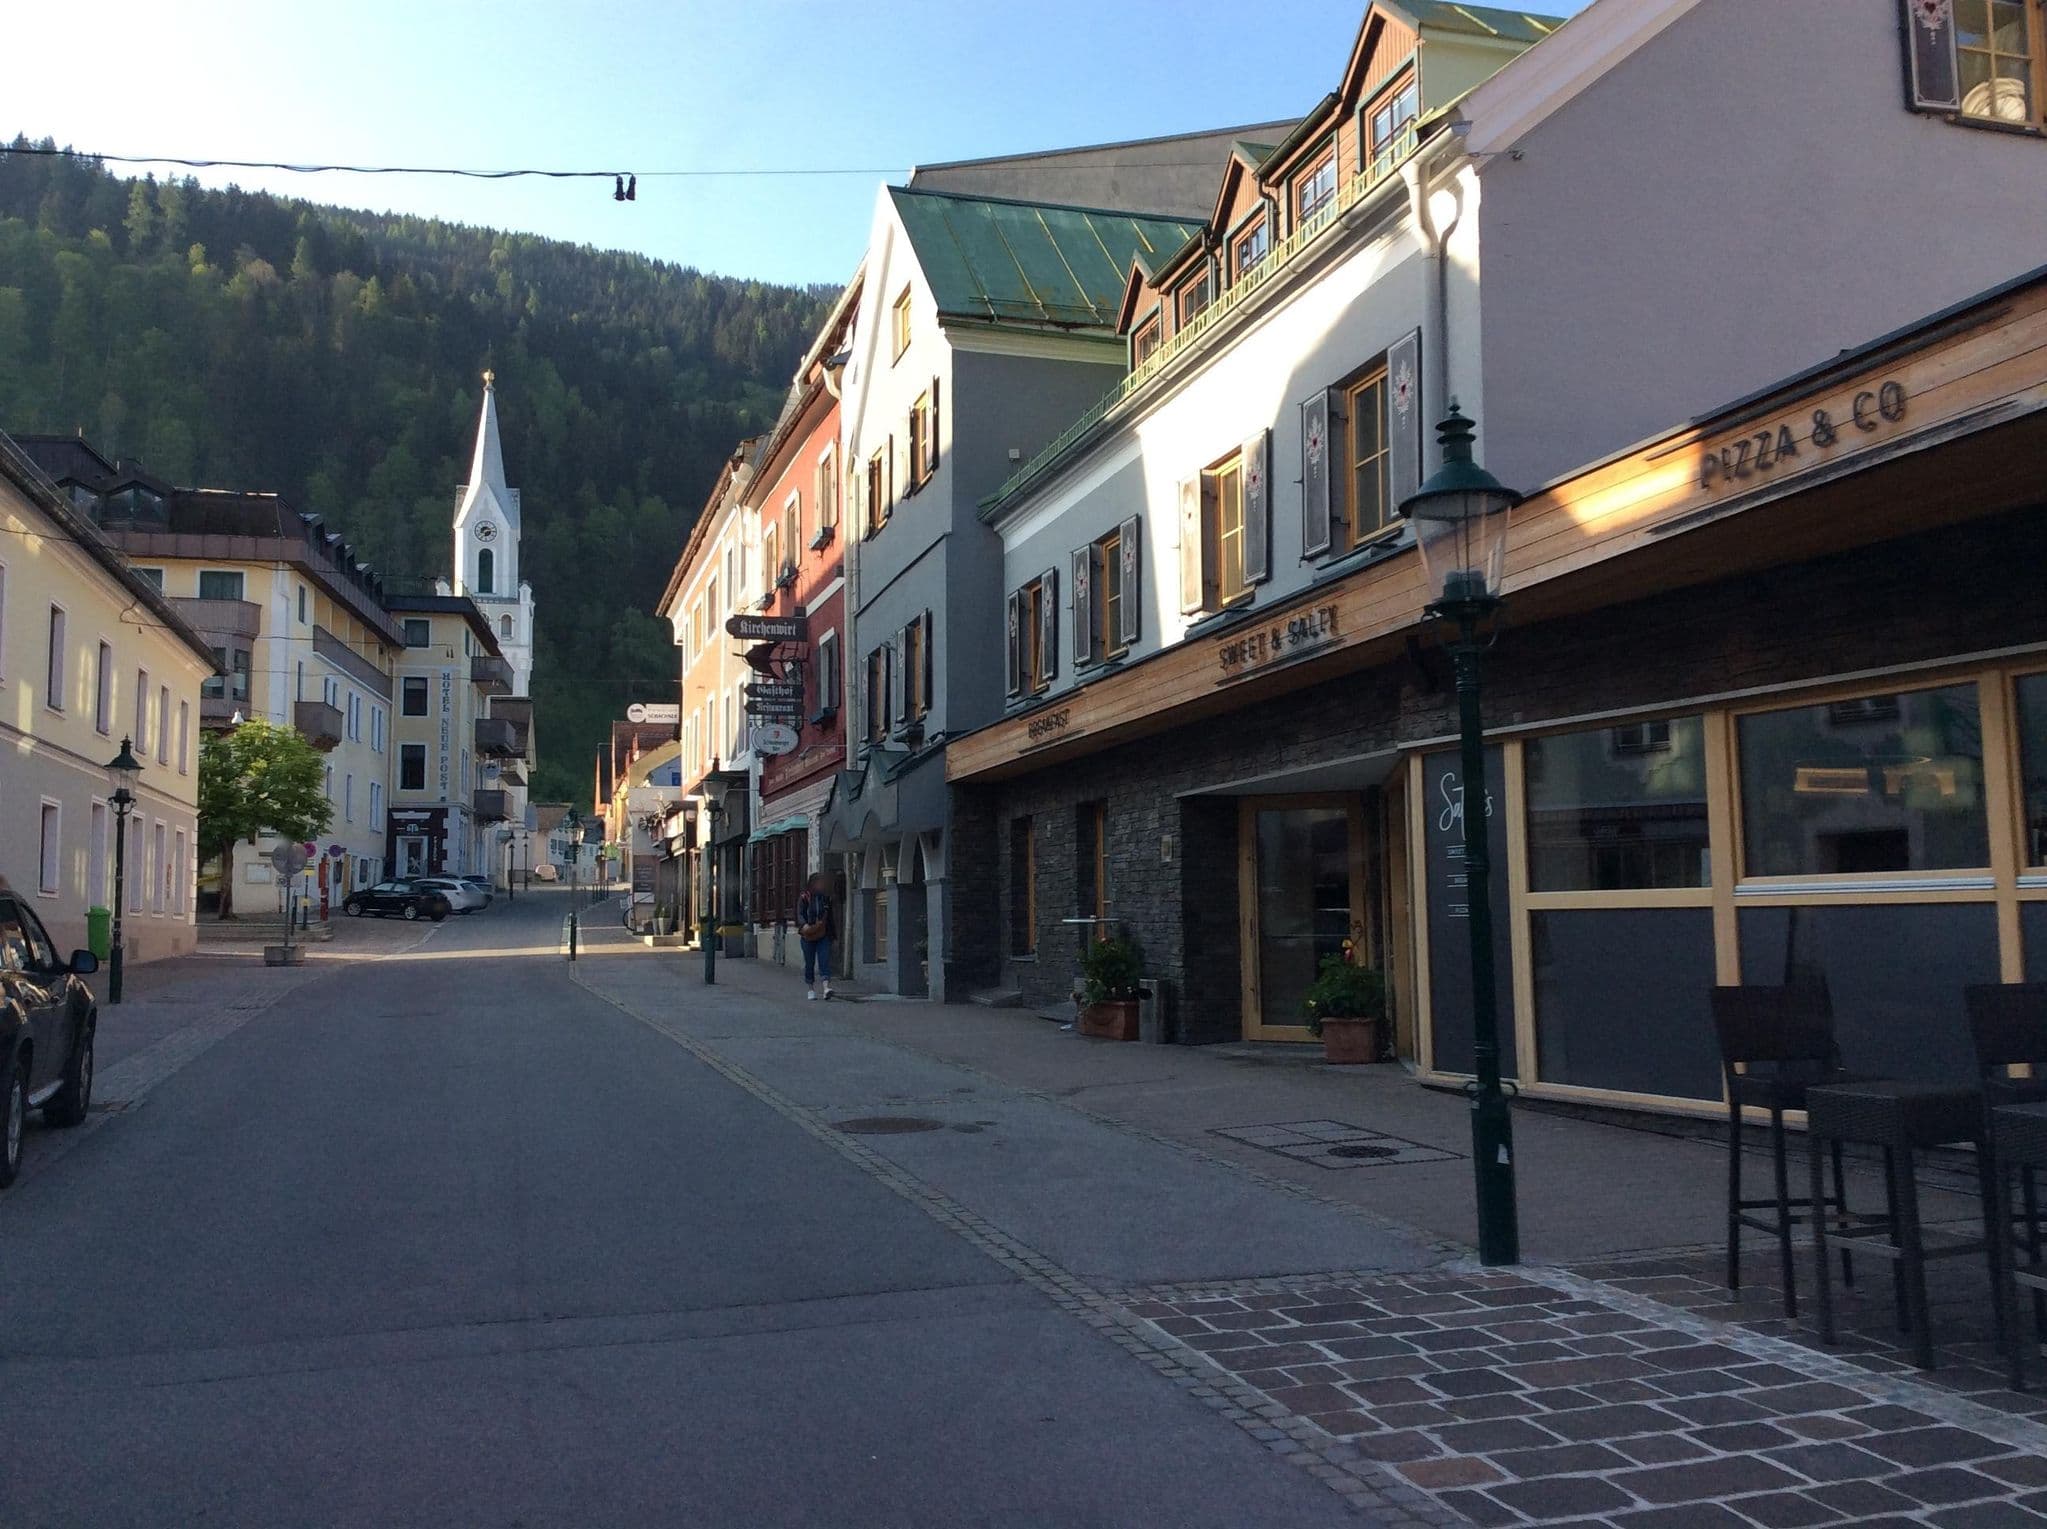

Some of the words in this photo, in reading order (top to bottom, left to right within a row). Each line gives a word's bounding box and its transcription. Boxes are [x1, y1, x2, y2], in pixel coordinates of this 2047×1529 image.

[1700, 423, 1798, 490] PIZZA
[1811, 408, 1837, 448] &
[1853, 380, 1907, 433] CO
[740, 620, 797, 637] Kirchenwirt
[1219, 632, 1266, 670] SWEET
[1271, 627, 1282, 651] &
[1287, 604, 1339, 646] SALTY
[442, 672, 451, 713] HOTEL
[439, 756, 448, 790] POST
